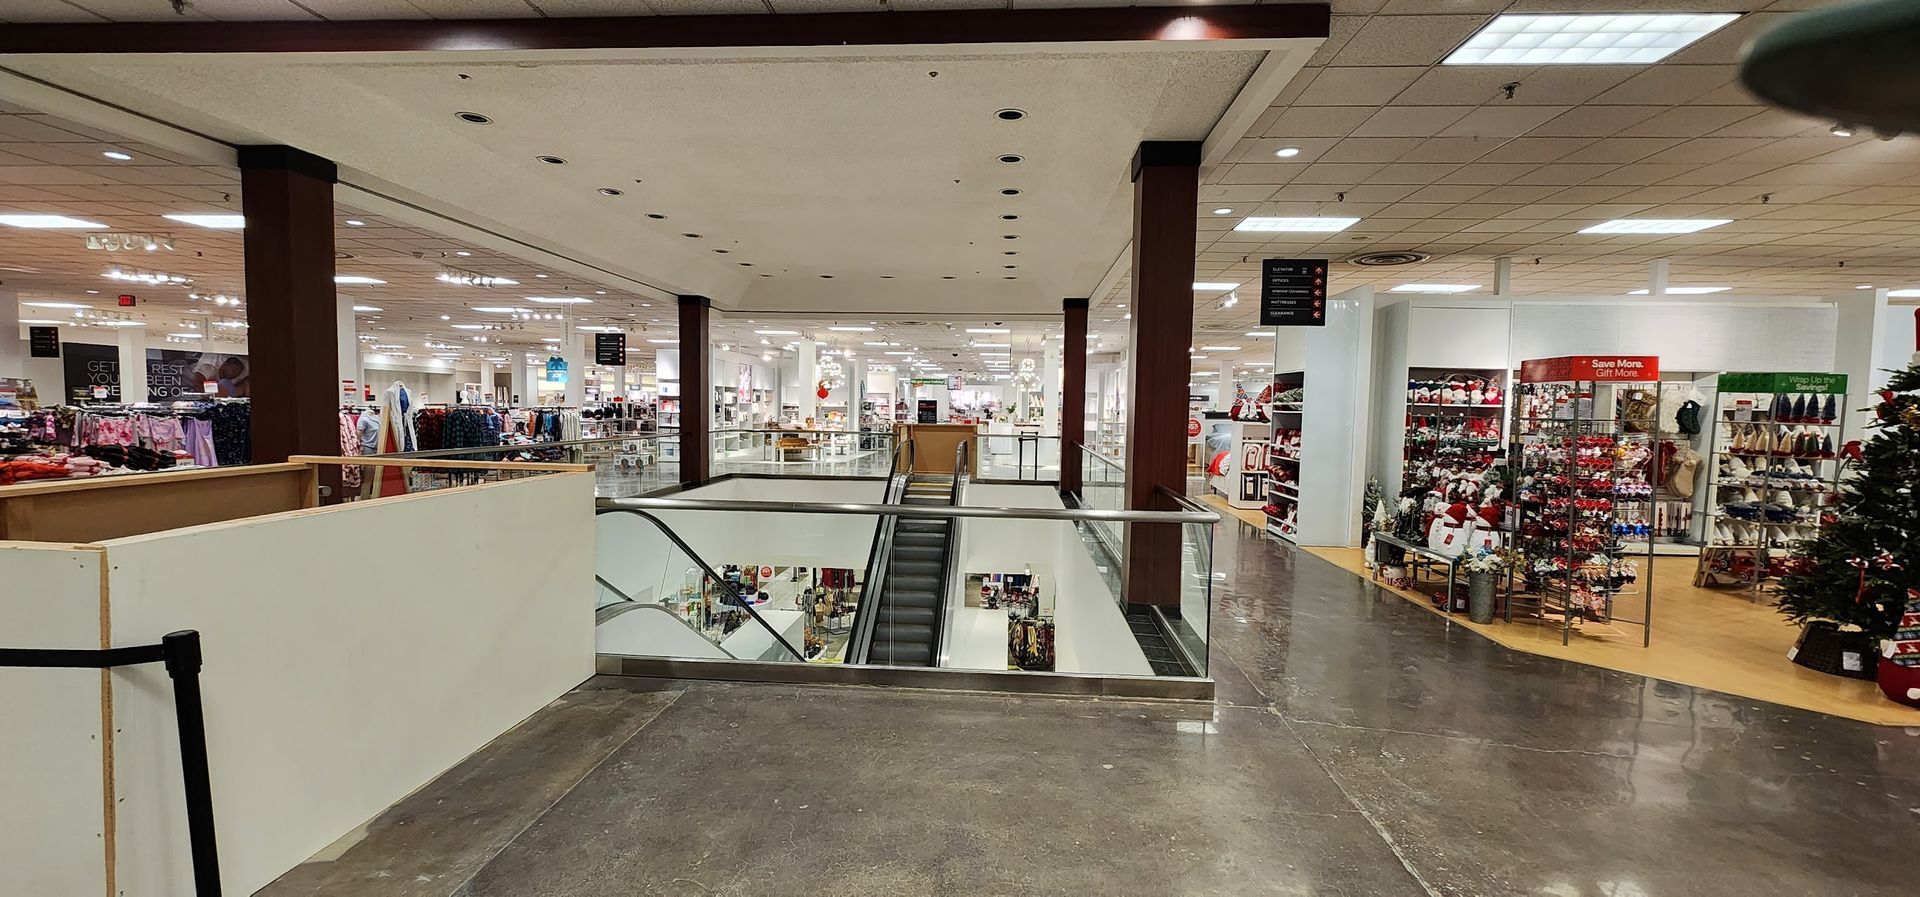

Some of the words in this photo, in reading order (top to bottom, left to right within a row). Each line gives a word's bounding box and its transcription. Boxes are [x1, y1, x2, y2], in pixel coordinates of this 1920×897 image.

[87, 360, 118, 372] GET
[1592, 359, 1616, 368] Save
[1617, 360, 1644, 368] More.
[151, 363, 185, 375] REST
[1595, 368, 1613, 378] Gift
[1614, 369, 1639, 378] More.
[147, 374, 182, 386] BEEN
[1789, 376, 1809, 384] Wrap
[1810, 376, 1823, 384] Up
[1796, 383, 1829, 392] Savings!
